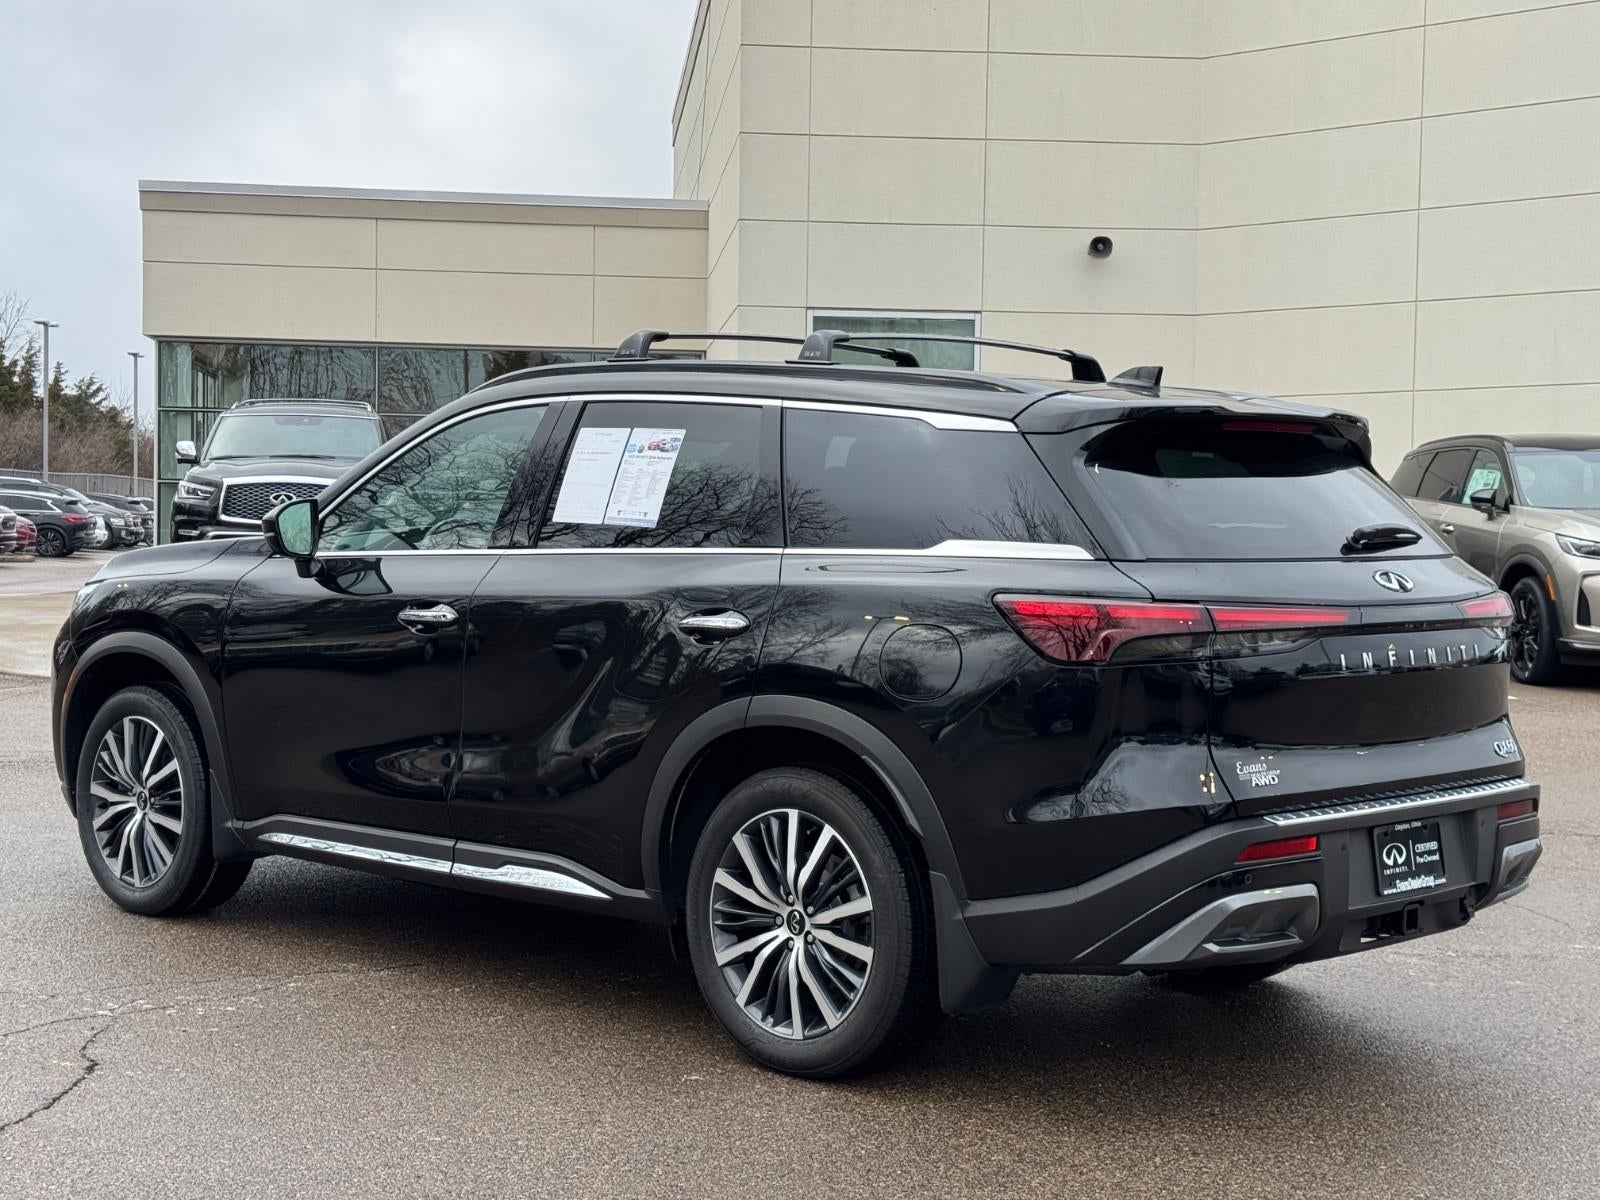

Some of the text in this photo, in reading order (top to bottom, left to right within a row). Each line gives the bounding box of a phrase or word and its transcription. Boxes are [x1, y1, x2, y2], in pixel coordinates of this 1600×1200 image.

[1339, 642, 1479, 671] INFINITI
[1235, 761, 1267, 775] Evans
[1251, 774, 1279, 788] AWD
[1415, 841, 1438, 852] CERTIFIED
